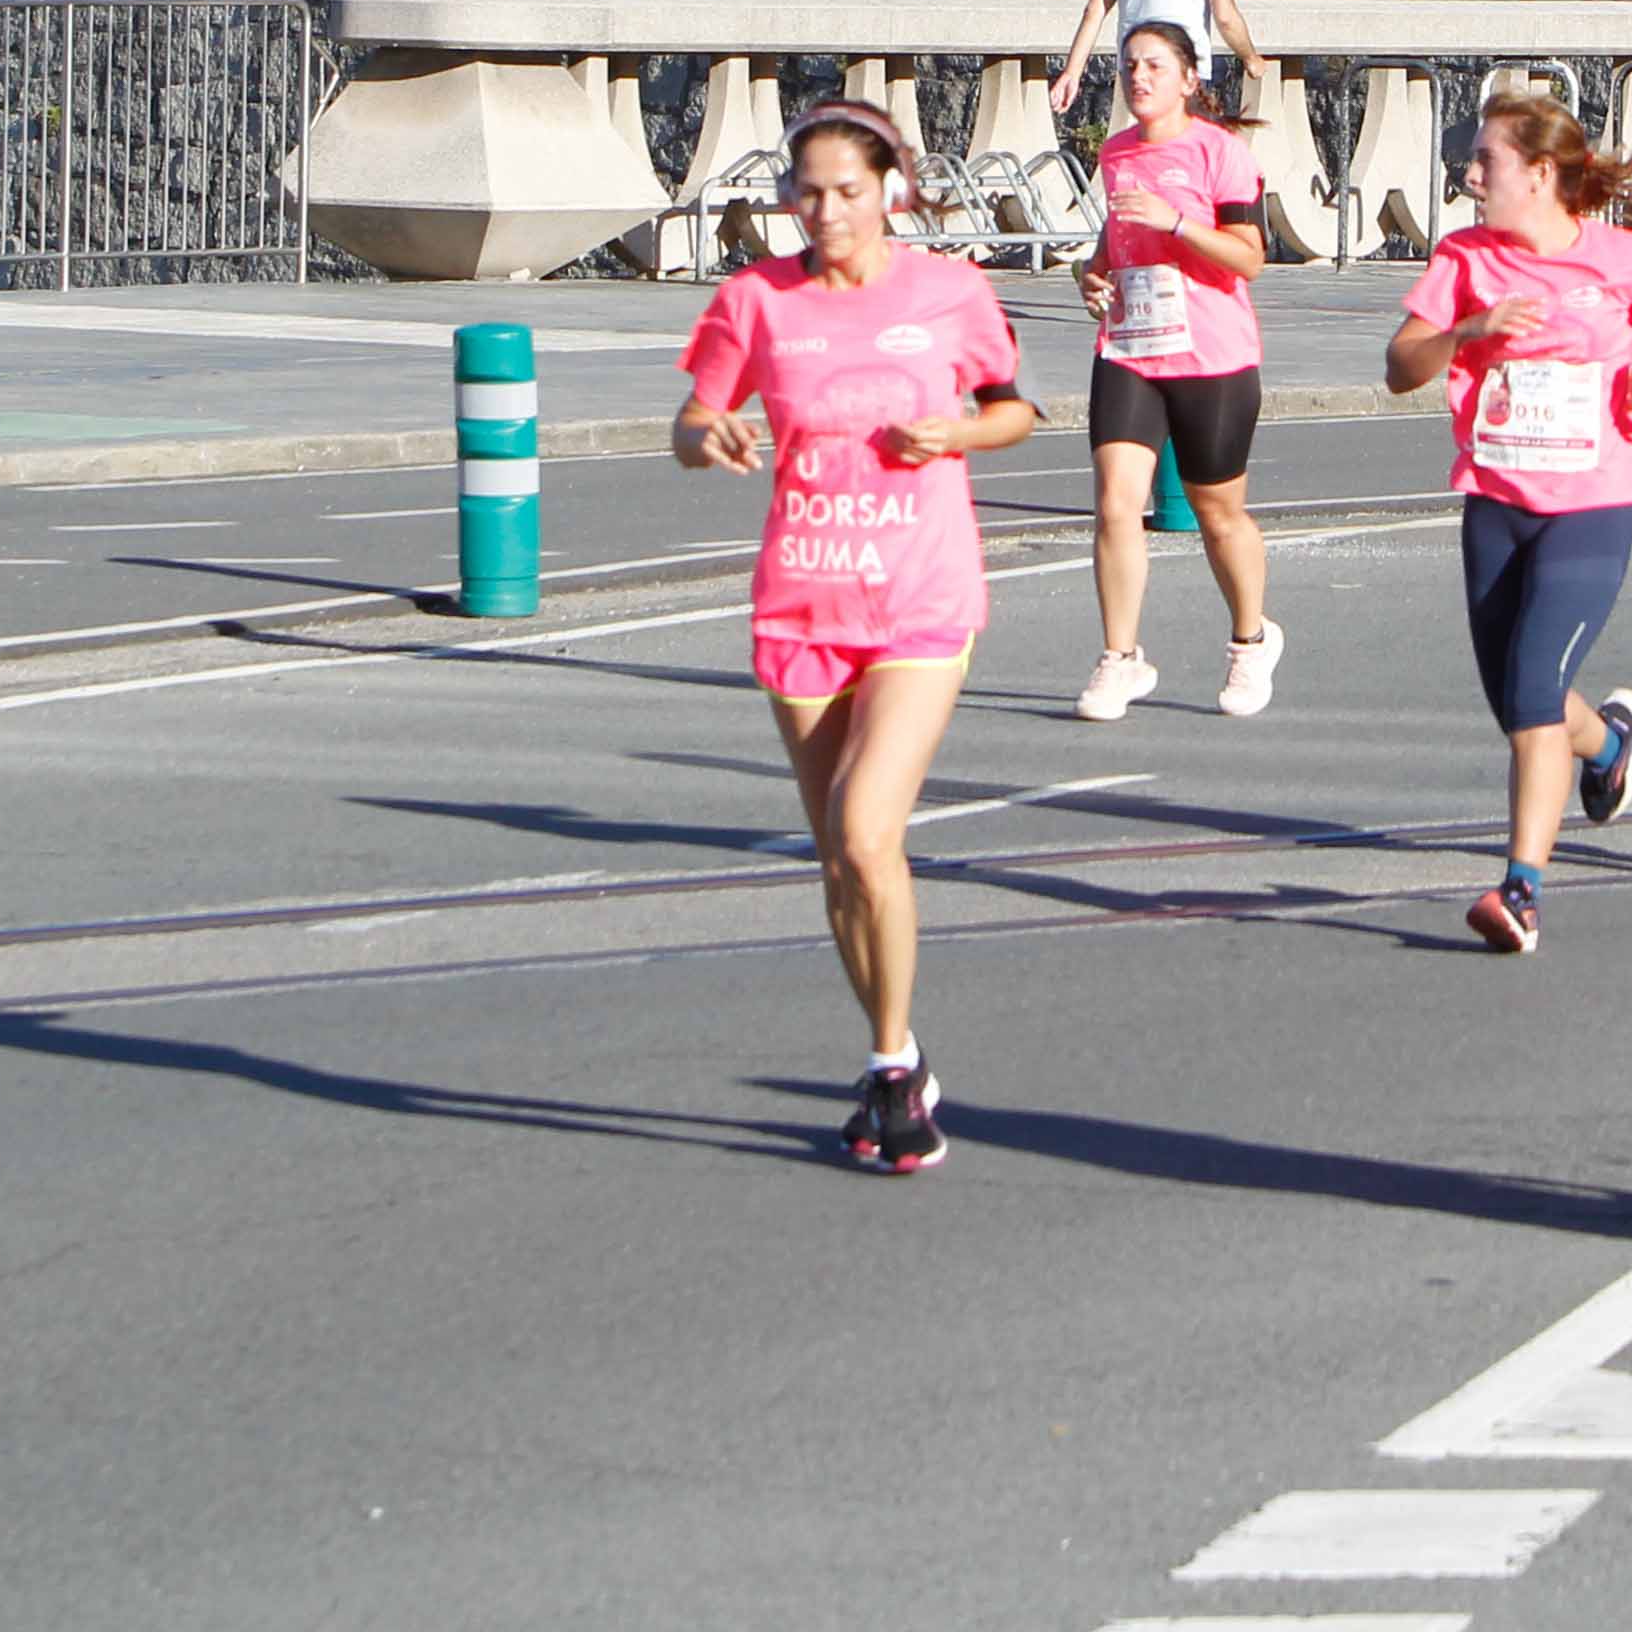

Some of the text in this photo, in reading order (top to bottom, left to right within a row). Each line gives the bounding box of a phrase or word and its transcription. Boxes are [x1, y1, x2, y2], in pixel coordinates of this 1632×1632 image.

[1515, 403, 1555, 422] 016
[786, 489, 919, 528] DORSAL
[780, 534, 884, 572] SUMA
